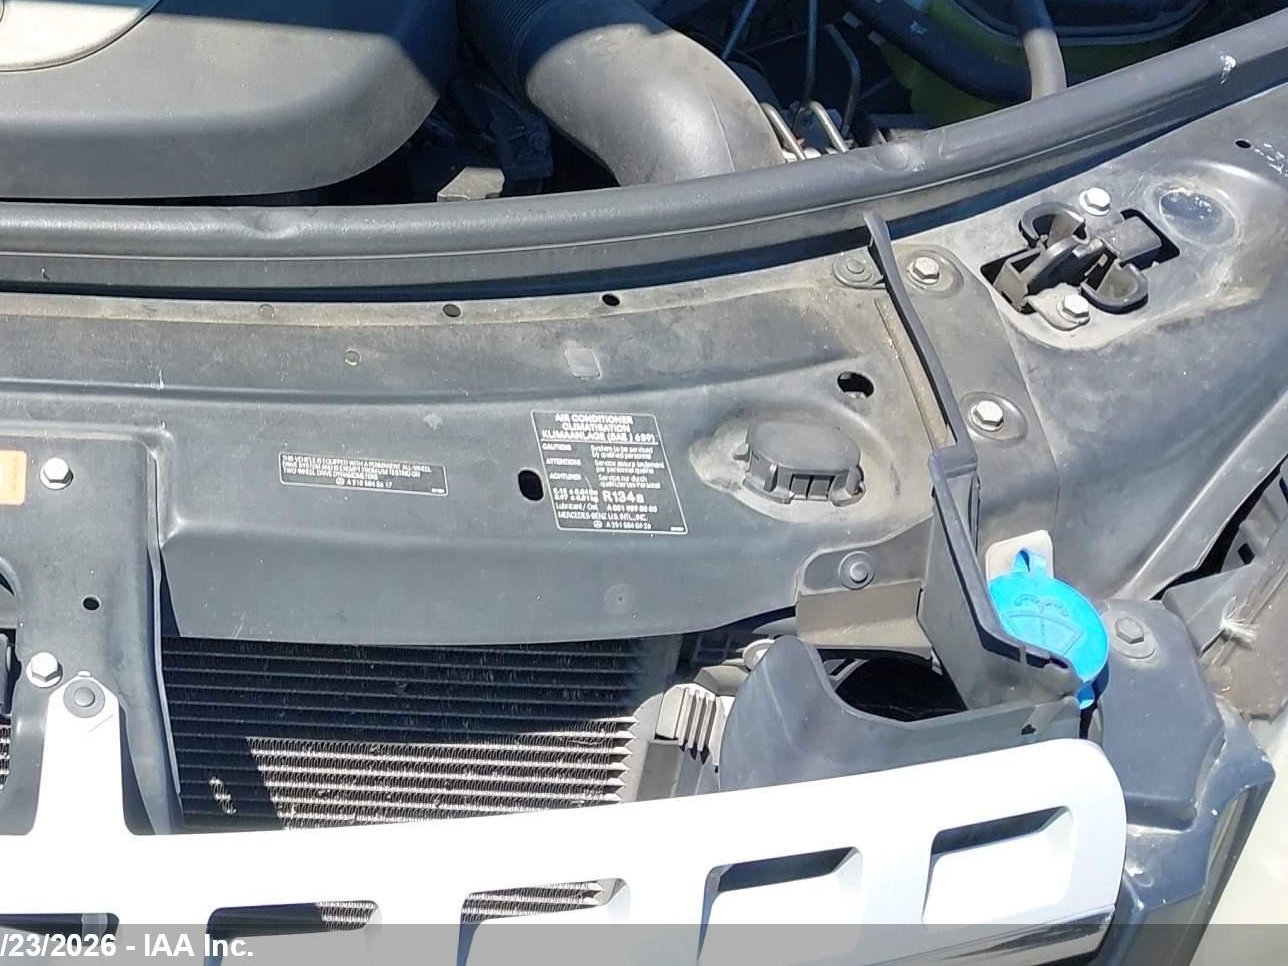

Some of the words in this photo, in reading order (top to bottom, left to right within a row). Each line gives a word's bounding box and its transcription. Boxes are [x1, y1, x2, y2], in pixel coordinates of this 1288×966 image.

[554, 413, 570, 421] AIR
[570, 413, 633, 423] CONDITIONER
[601, 490, 645, 503] R134a
